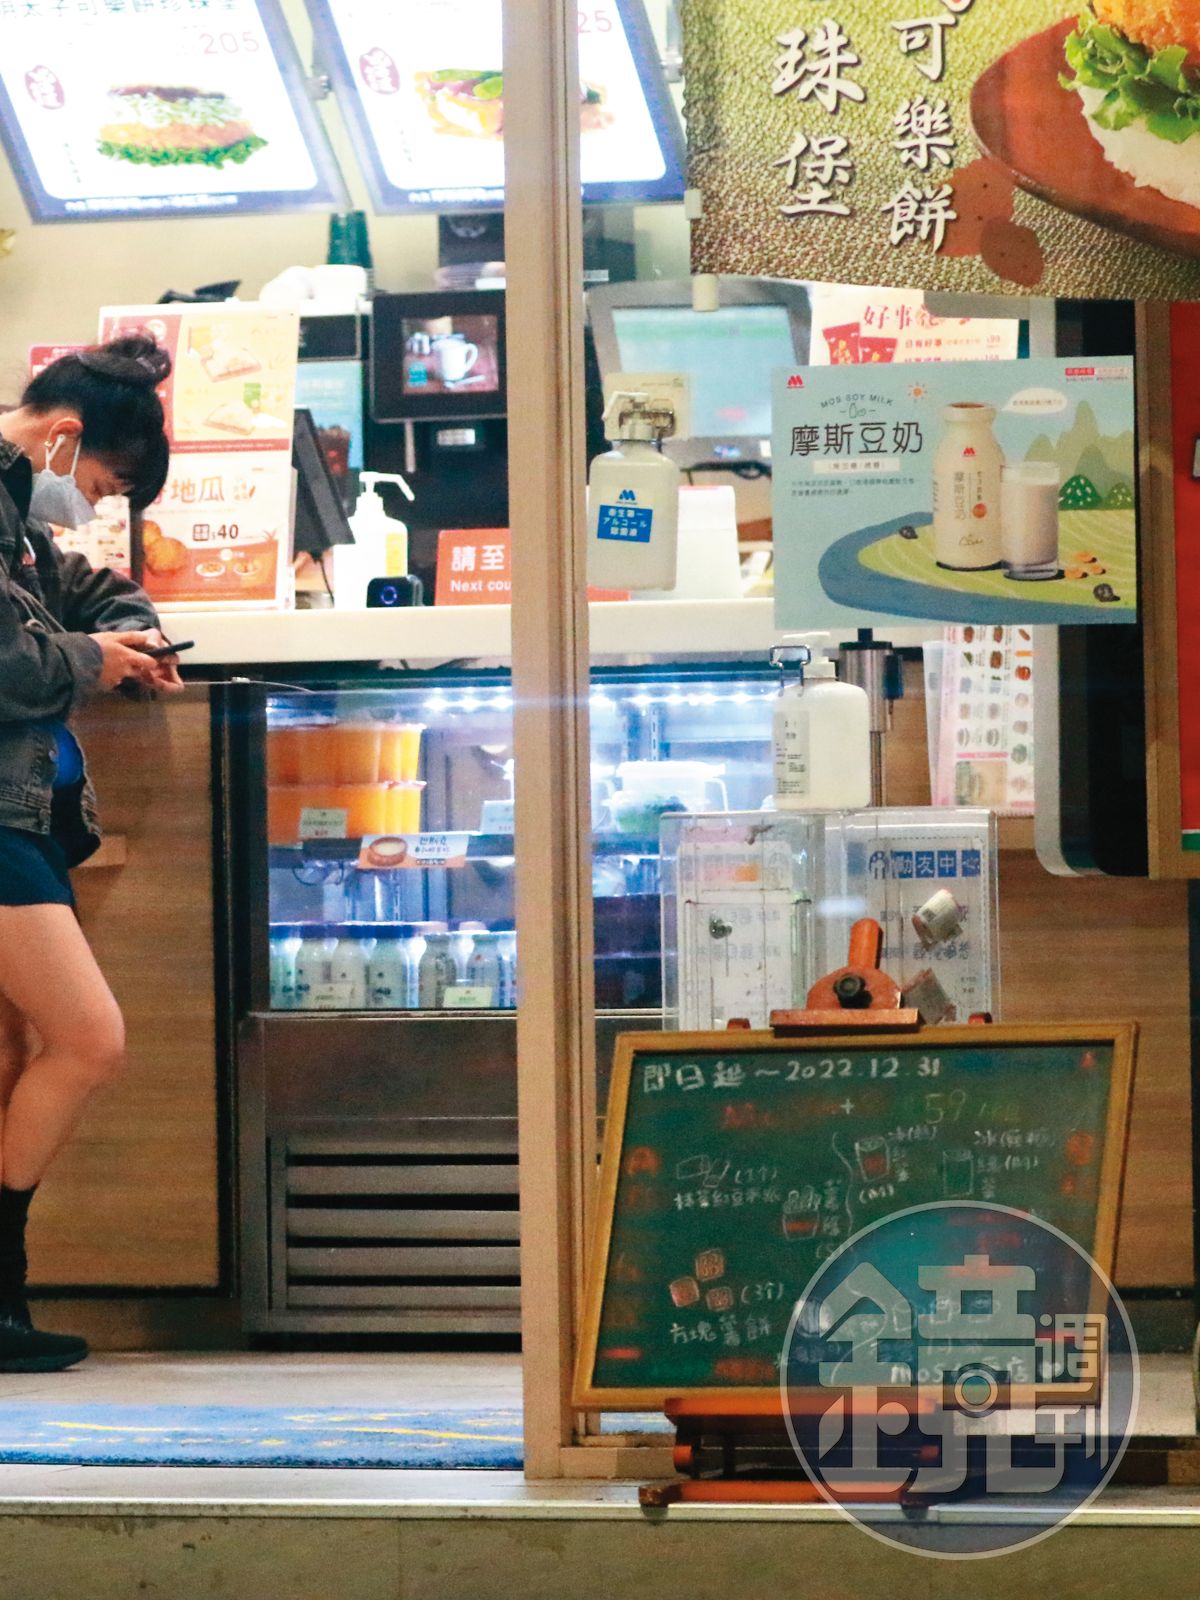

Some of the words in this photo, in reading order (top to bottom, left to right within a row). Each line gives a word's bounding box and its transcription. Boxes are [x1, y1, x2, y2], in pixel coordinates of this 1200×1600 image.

[199, 31, 260, 54] 205
[882, 14, 957, 253] 可樂餅
[820, 396, 841, 408] MOS
[846, 393, 866, 402] SOY
[870, 394, 893, 406] MILK
[790, 421, 923, 457] 摩斯豆奶
[450, 580, 483, 592] Next
[487, 580, 512, 592] cou
